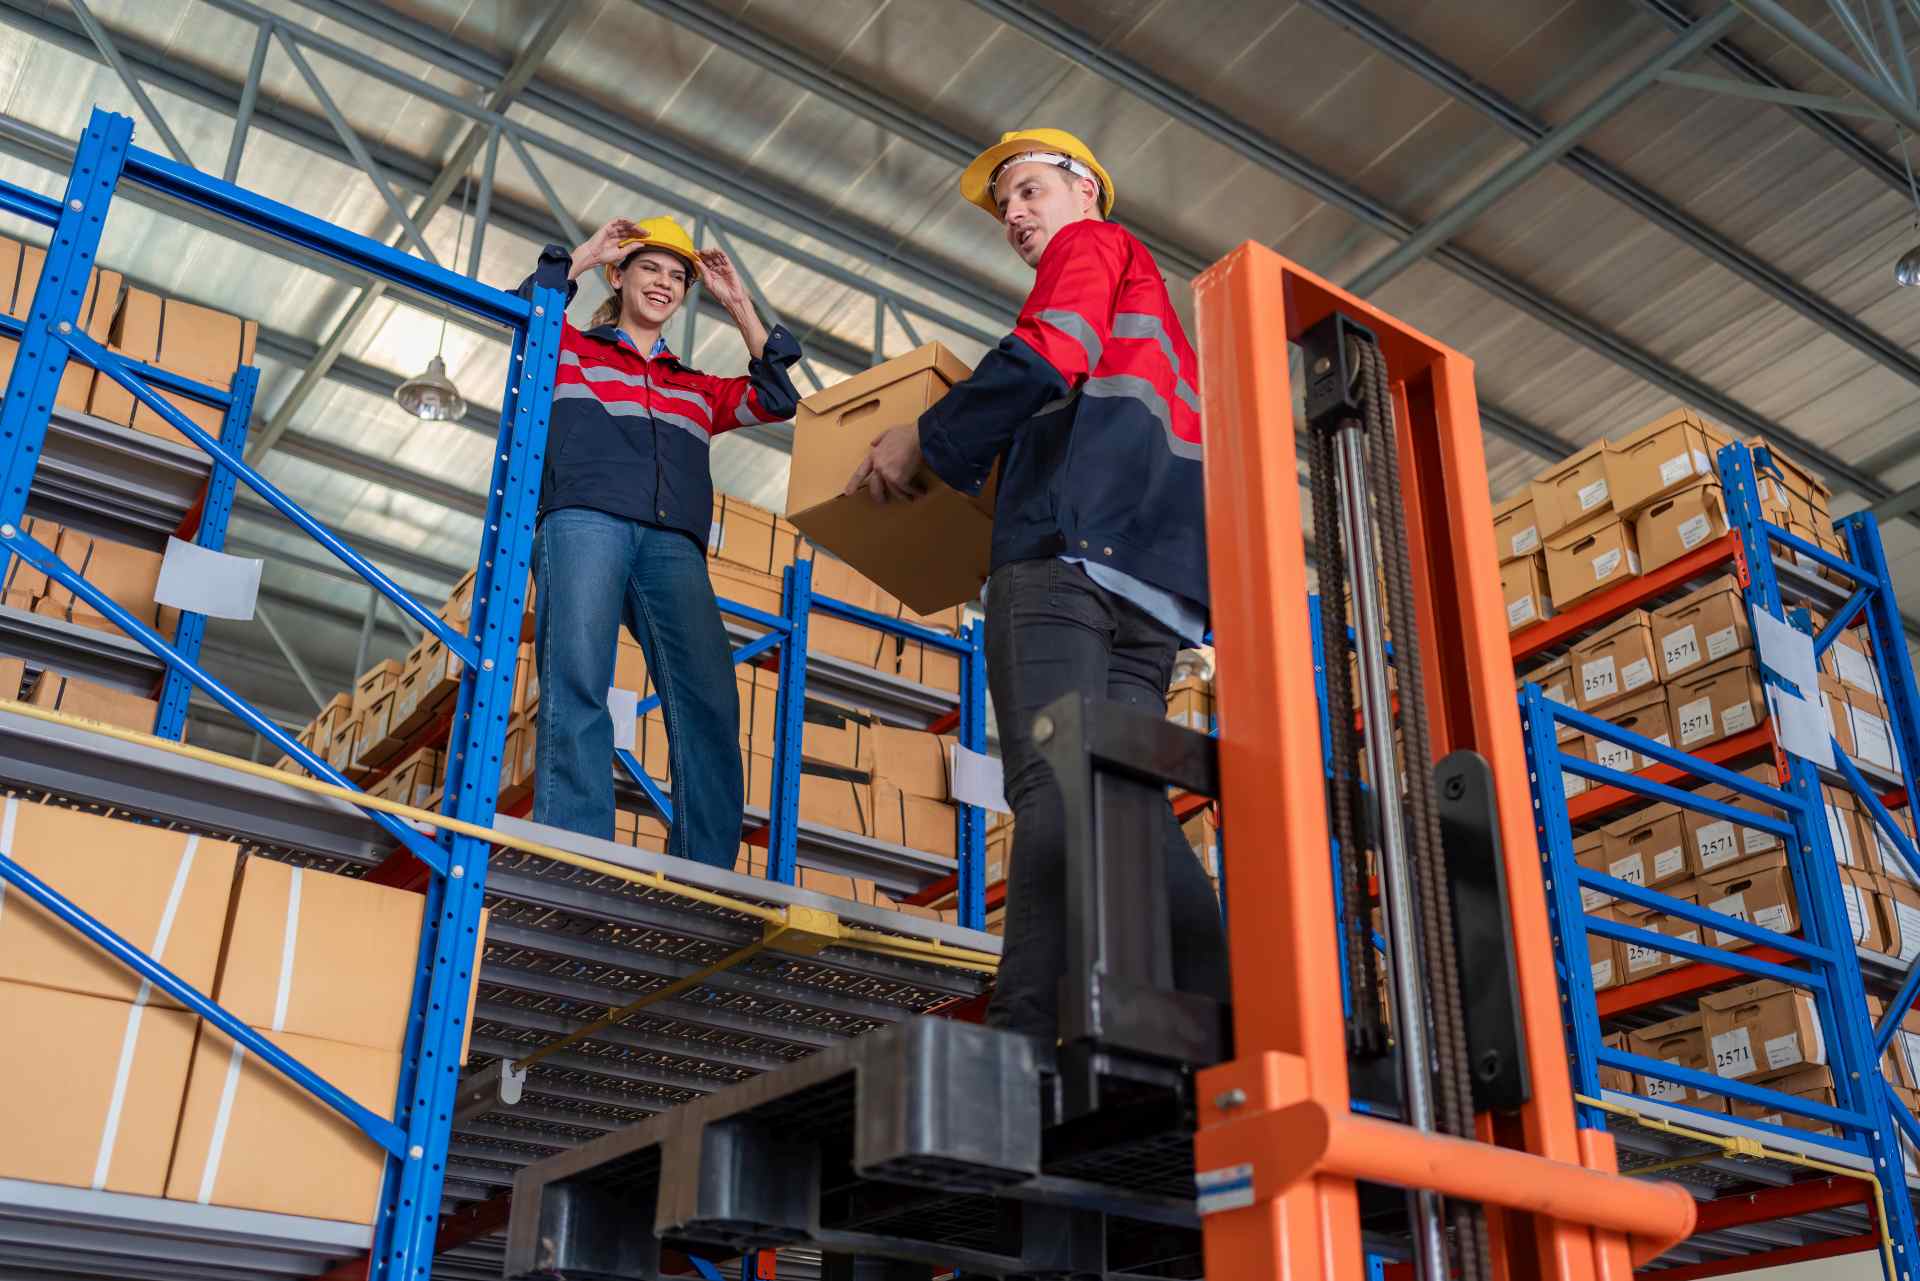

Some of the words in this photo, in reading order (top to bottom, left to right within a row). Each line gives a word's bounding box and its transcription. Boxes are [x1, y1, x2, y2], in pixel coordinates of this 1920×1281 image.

[1666, 640, 1696, 663] 2571
[1584, 672, 1613, 690] 2571
[1682, 714, 1709, 734] 2571
[1601, 749, 1628, 767] 2571
[1702, 835, 1733, 856] 2571
[1717, 1046, 1748, 1068] 2571
